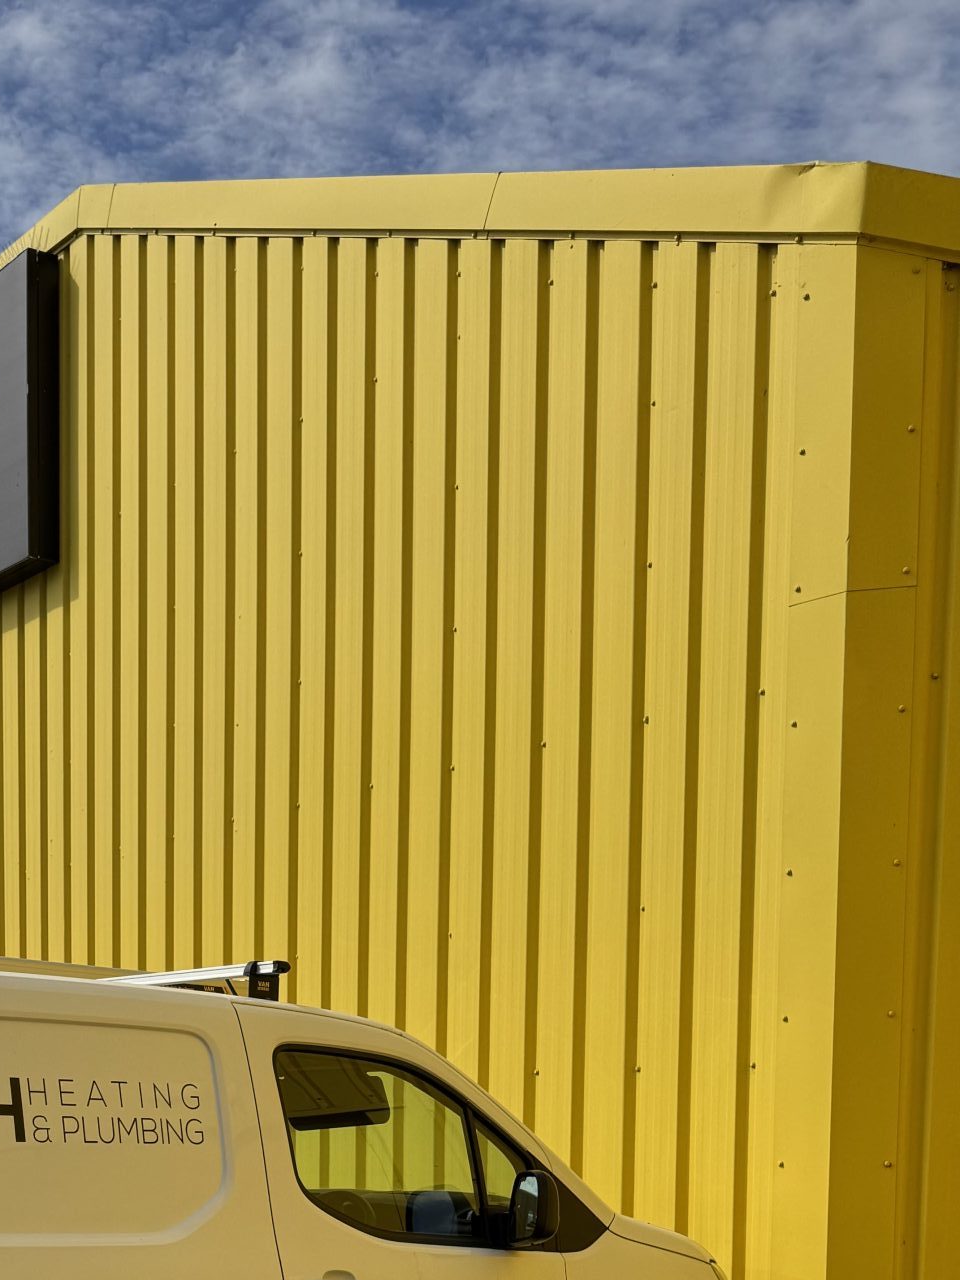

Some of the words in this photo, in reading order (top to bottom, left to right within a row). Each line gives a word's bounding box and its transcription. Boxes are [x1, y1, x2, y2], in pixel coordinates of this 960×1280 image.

[27, 1077, 201, 1110] HEATING
[32, 1115, 52, 1143] &
[61, 1115, 205, 1145] PLUMBING
